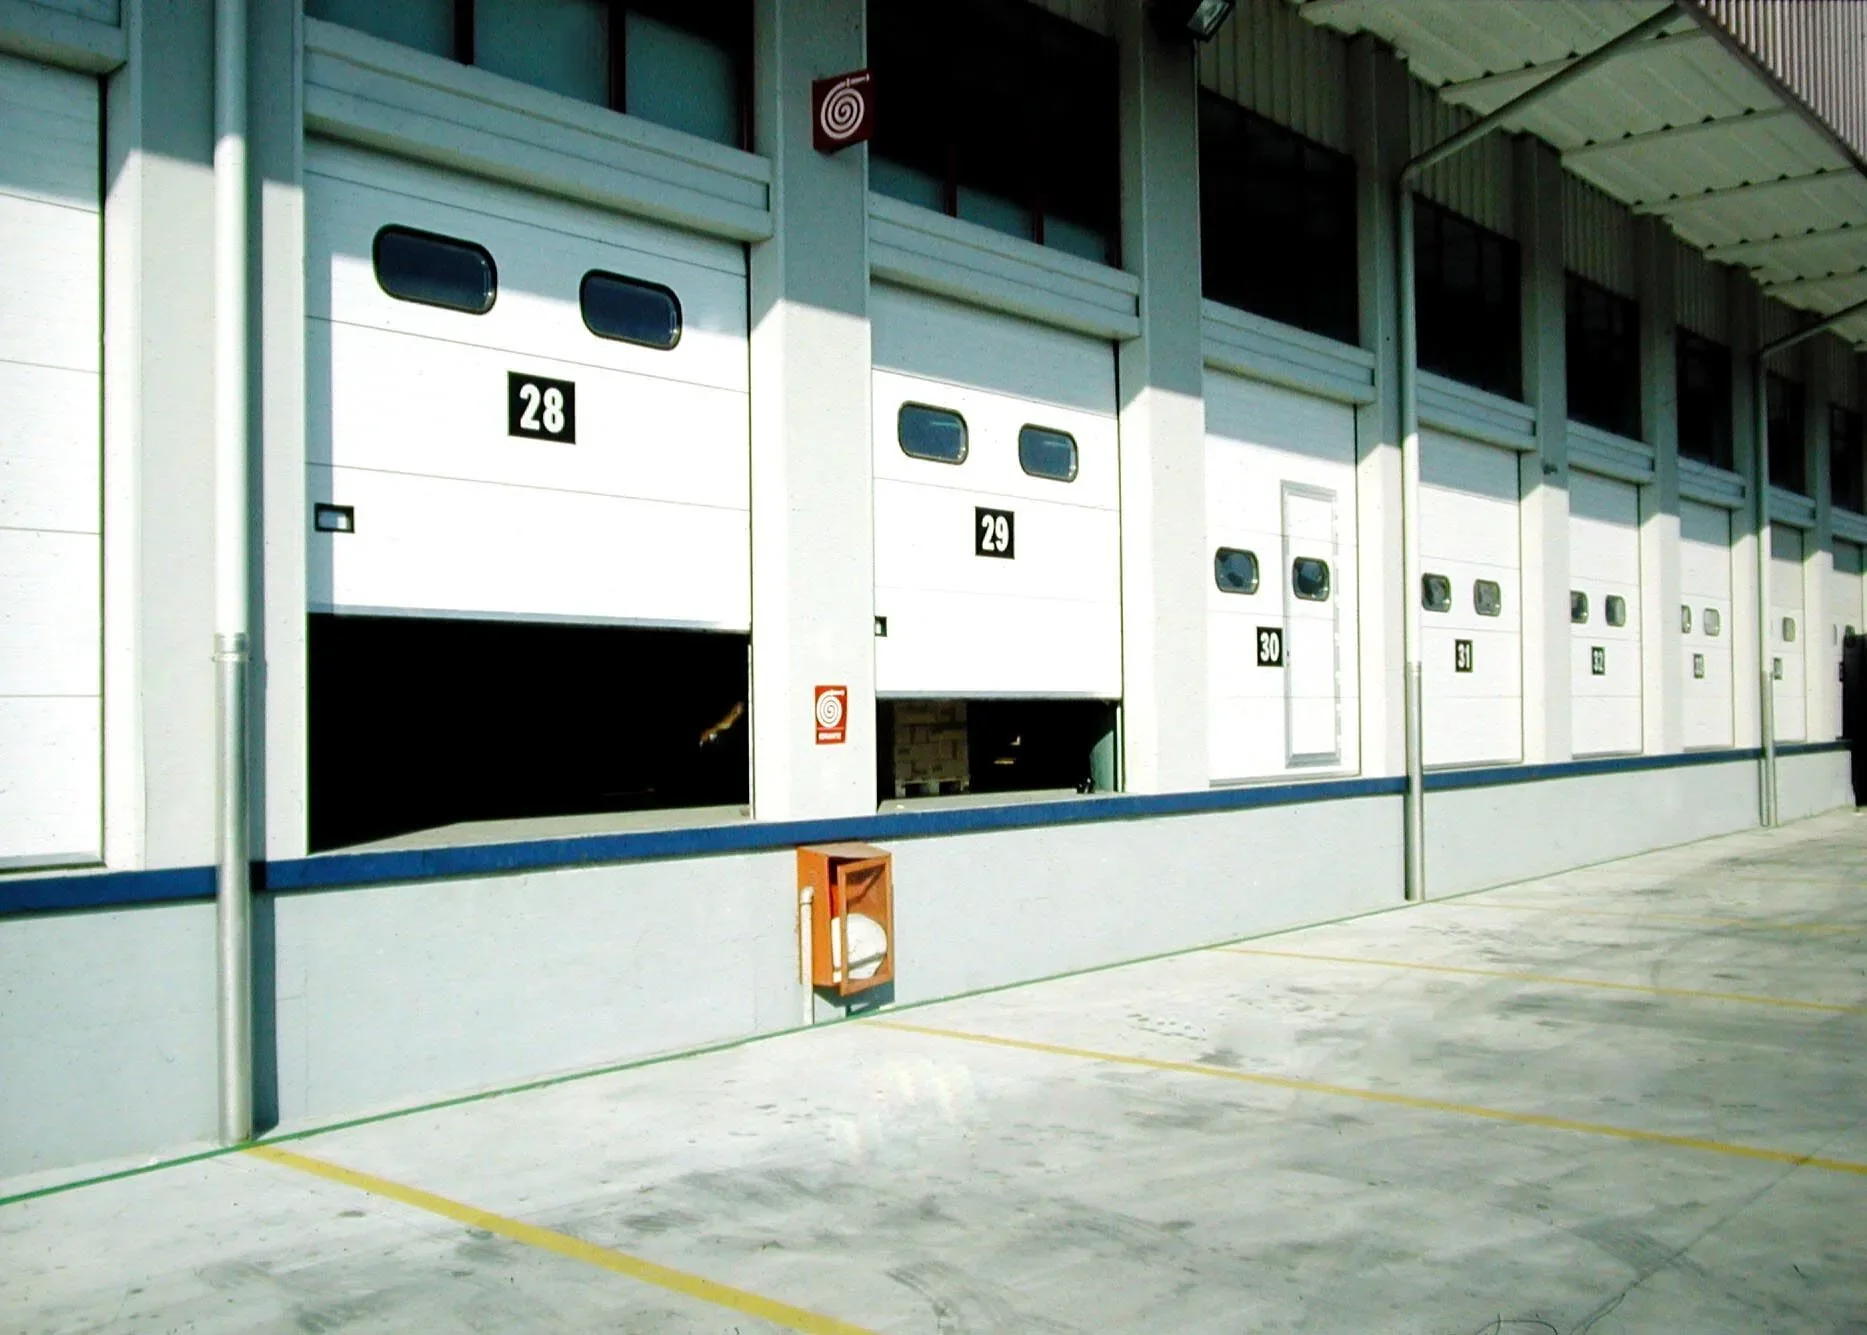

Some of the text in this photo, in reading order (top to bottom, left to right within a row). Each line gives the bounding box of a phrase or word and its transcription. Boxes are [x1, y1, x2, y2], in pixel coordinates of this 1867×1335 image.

[519, 383, 565, 433] 28
[981, 514, 1009, 552] 29
[1260, 631, 1280, 662] 30
[1458, 643, 1470, 669] 31
